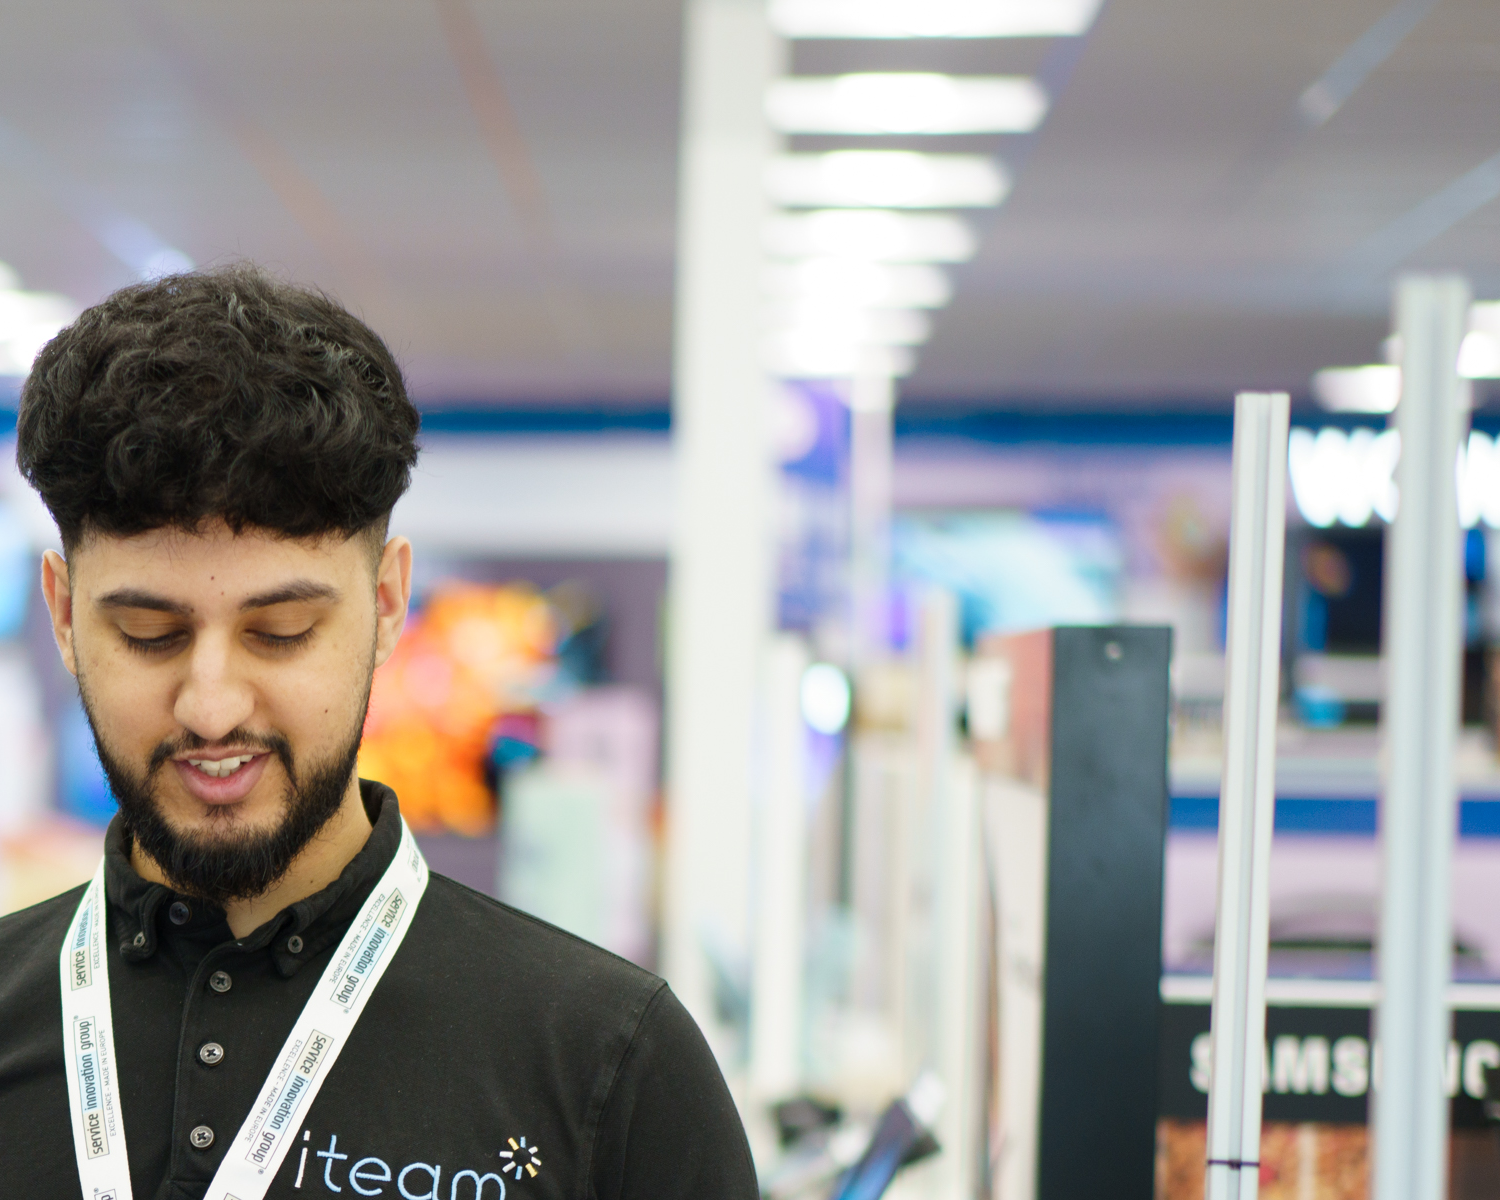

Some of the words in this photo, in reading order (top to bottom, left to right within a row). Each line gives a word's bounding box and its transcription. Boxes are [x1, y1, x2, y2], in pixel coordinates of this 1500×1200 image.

[360, 893, 386, 931] EXCELLENCE
[381, 894, 403, 928] service
[343, 951, 351, 961] IN
[347, 934, 361, 953] MADE
[353, 927, 390, 975] innovation
[73, 950, 87, 986] service
[329, 959, 347, 984] EUROPE
[336, 974, 360, 1004] group
[79, 1020, 94, 1050] group
[98, 1029, 107, 1056] EUROPE
[101, 1057, 108, 1066] IN
[277, 1039, 303, 1082] EXCELLENCE
[299, 1035, 327, 1075] service
[1189, 1033, 1500, 1099] SMSG
[81, 1053, 98, 1111] innovation
[102, 1067, 110, 1087] MADE
[260, 1107, 268, 1115] IN
[265, 1087, 279, 1108] MADE
[270, 1075, 308, 1130] innovation
[106, 1092, 116, 1137] EXCELLENCE
[244, 1115, 263, 1143] EUROPE
[87, 1113, 103, 1158] service
[251, 1130, 276, 1163] group
